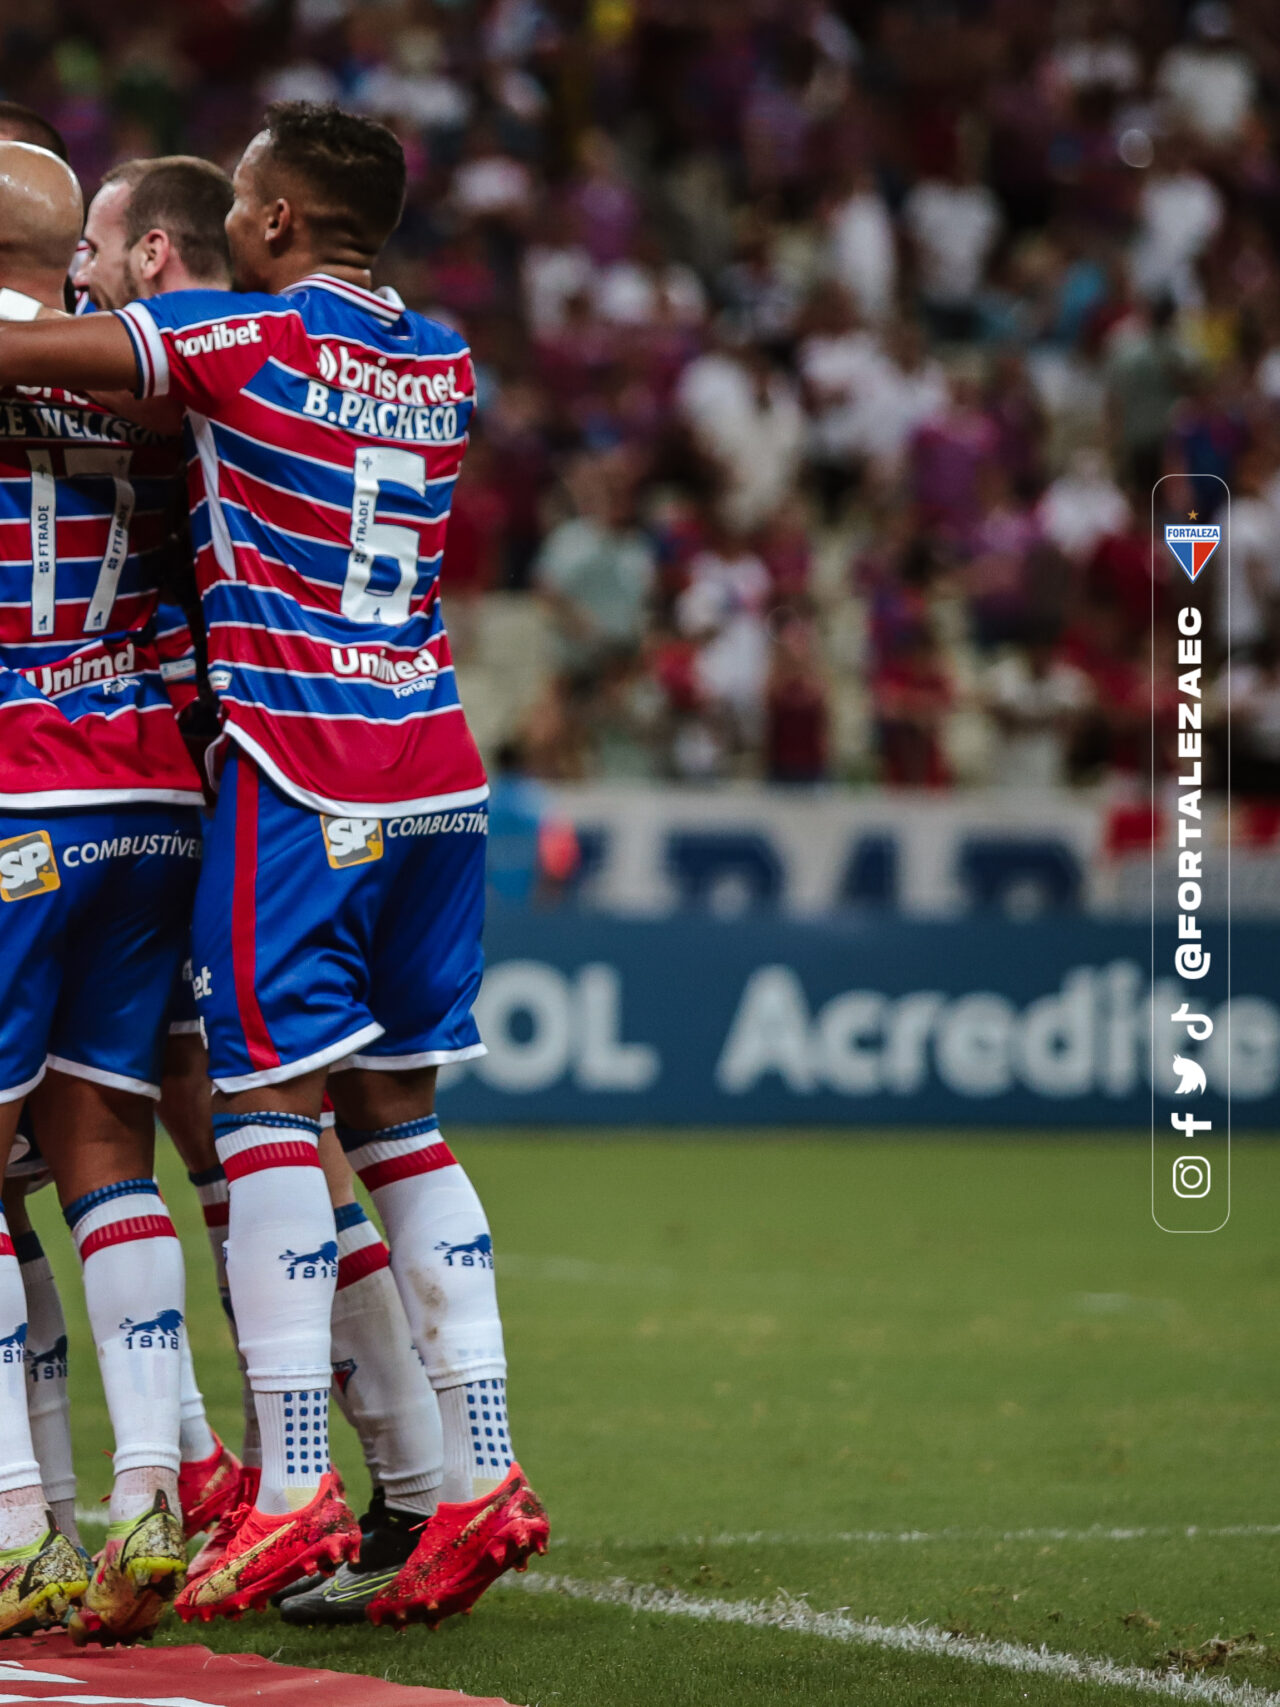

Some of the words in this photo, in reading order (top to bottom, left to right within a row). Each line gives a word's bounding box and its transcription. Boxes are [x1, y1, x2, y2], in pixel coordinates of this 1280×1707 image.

[26, 449, 134, 637] 17
[38, 505, 50, 558] FTRADE
[340, 446, 427, 626] 6
[124, 1335, 180, 1351] 1918
